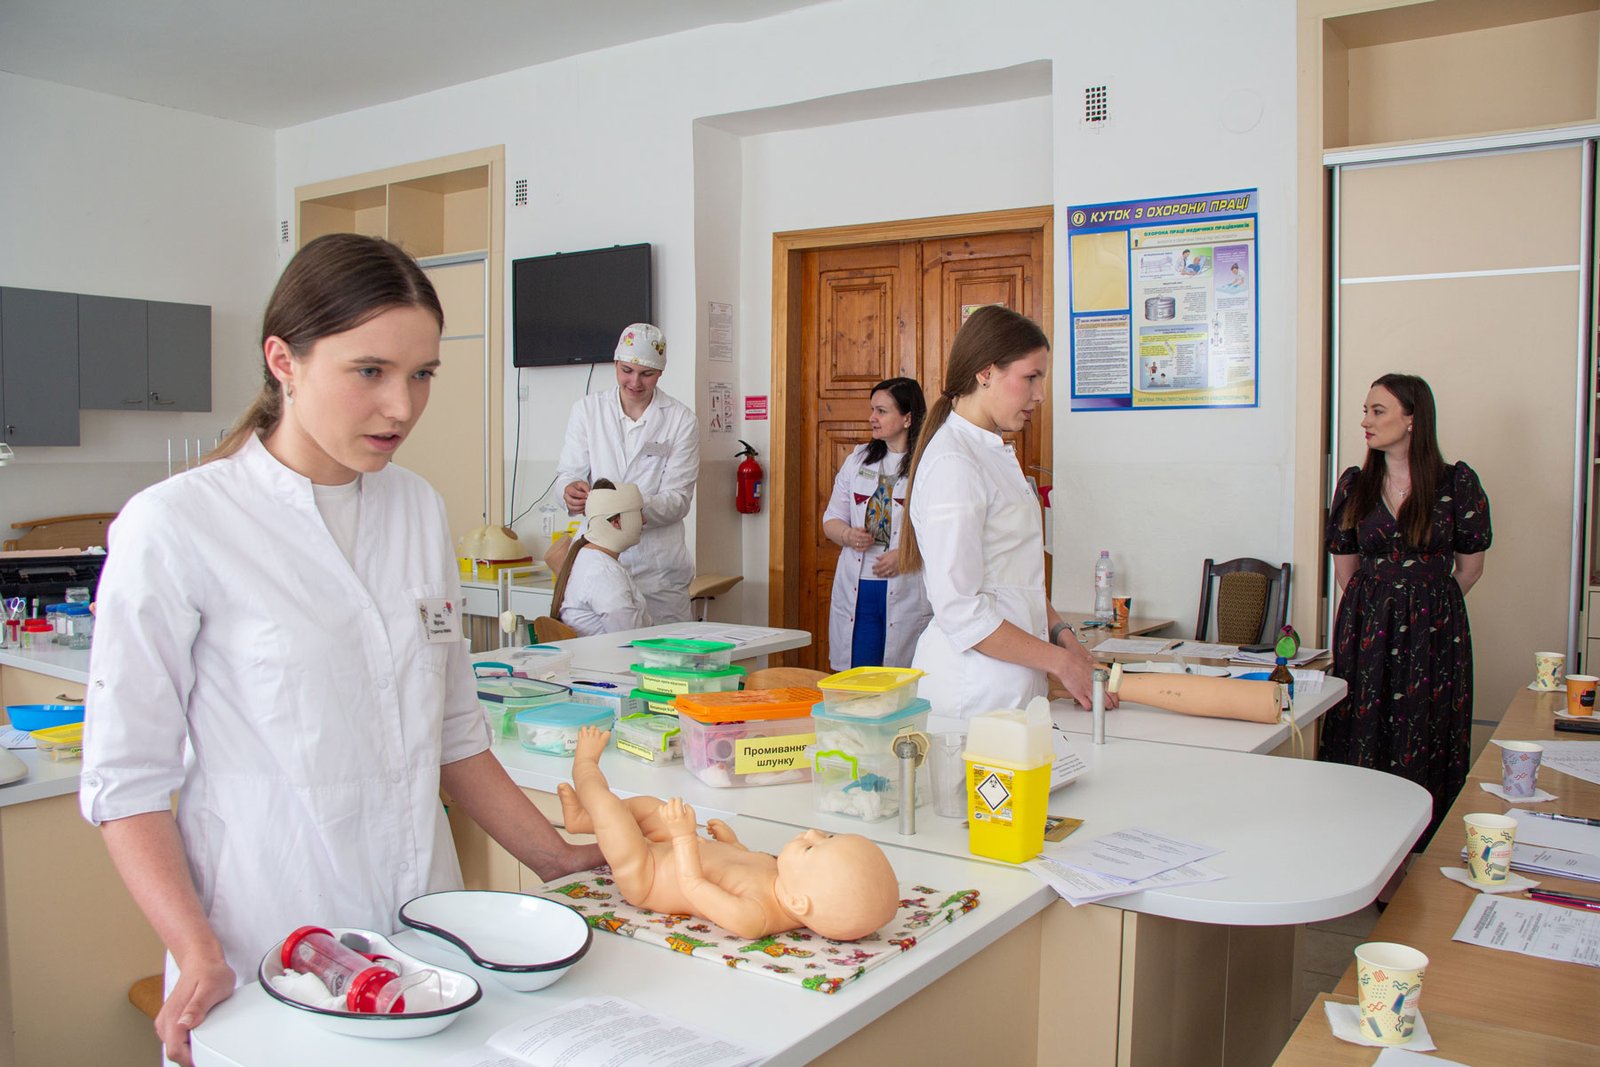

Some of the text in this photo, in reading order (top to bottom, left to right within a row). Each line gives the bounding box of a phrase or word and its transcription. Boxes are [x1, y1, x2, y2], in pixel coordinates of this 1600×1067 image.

[1090, 194, 1250, 223] КУТОК З ОХОРОНИ ПРАЦІ
[743, 744, 808, 757] Промивання
[757, 757, 795, 768] шлунку
